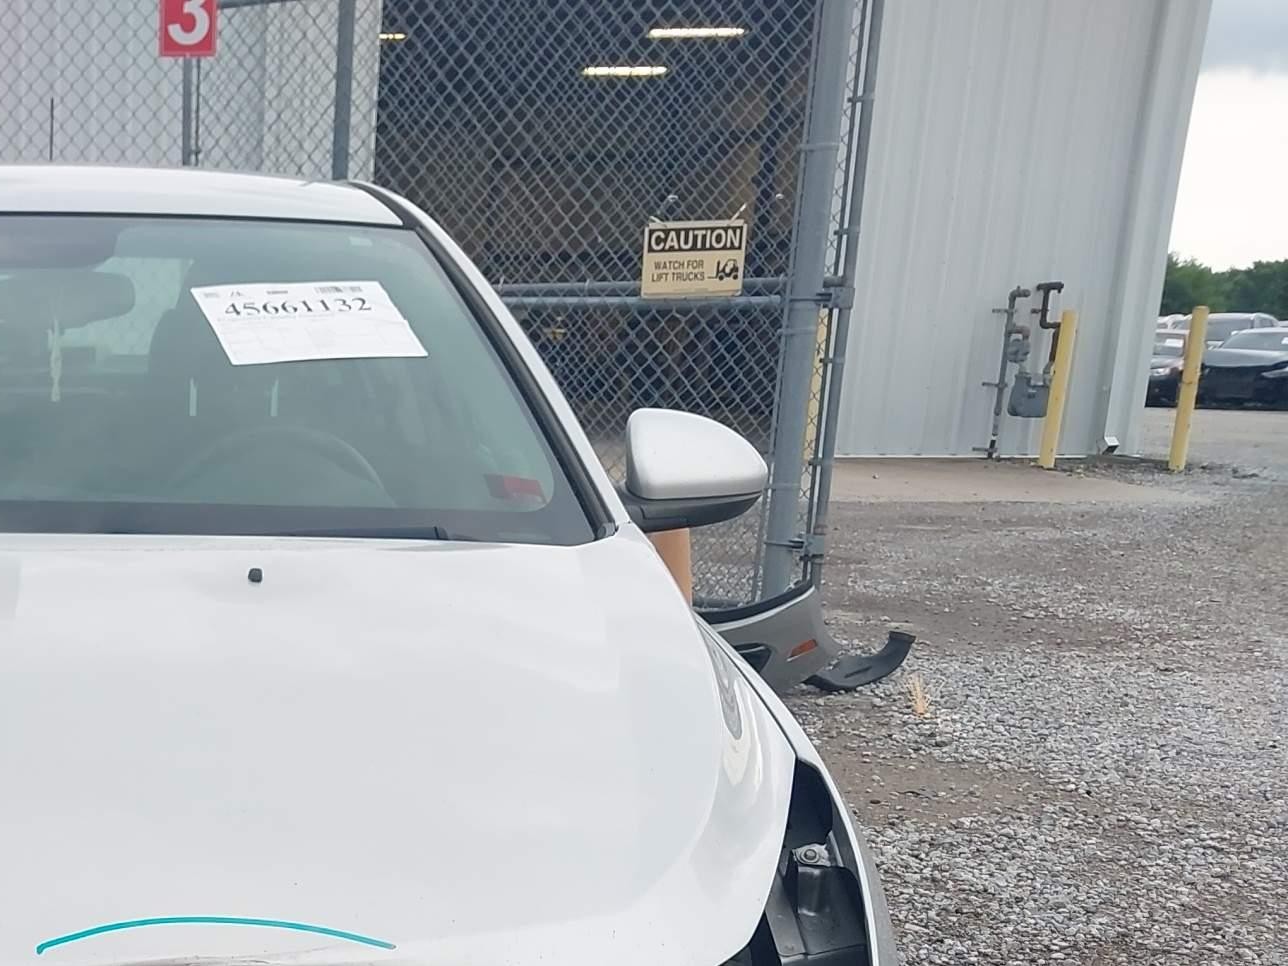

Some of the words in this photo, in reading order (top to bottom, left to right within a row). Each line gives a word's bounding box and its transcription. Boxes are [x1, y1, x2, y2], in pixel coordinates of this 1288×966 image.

[167, 0, 210, 45] 3
[650, 228, 740, 251] CAUTION
[654, 260, 685, 271] WATCH
[686, 259, 704, 270] FOR
[651, 272, 669, 282] LIFT
[671, 271, 705, 281] TRUCKS
[224, 297, 372, 316] 45661132
